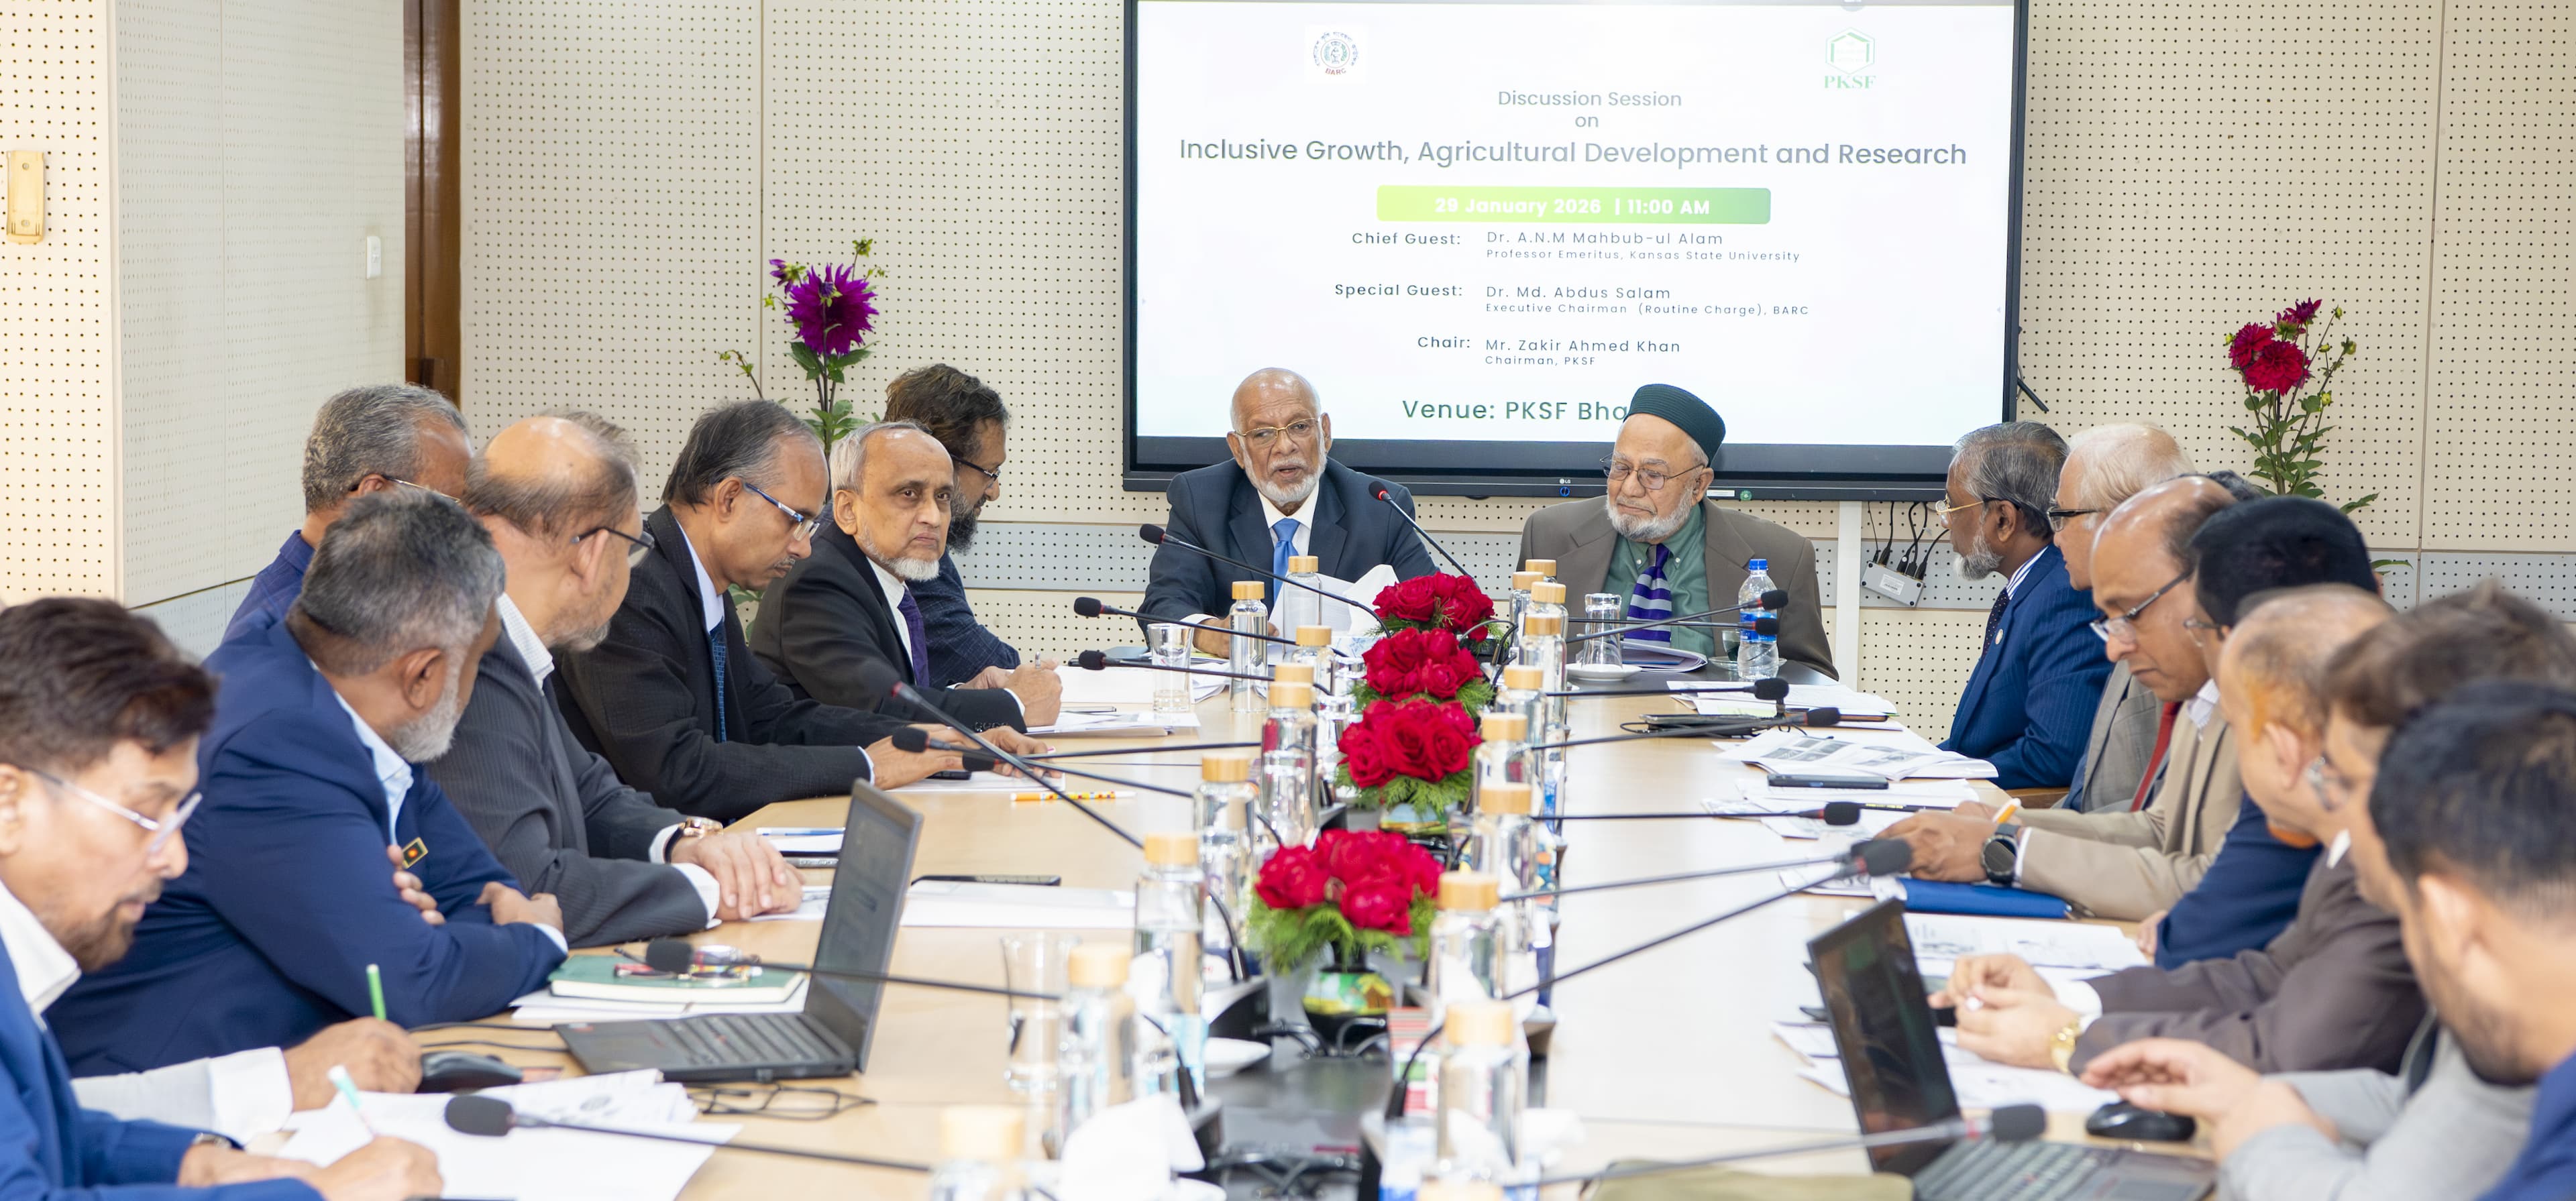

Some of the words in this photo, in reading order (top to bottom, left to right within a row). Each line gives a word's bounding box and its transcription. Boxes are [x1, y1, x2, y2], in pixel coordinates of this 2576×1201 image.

[1325, 68, 1347, 76] BARC
[1824, 75, 1877, 89] PKSF
[1498, 89, 1602, 106] Discussion
[1608, 91, 1682, 107] Session
[1574, 116, 1599, 128] on
[1181, 138, 1298, 160] Inclusive
[1305, 140, 1409, 164] Growth,
[1417, 139, 1576, 168] Agricultural
[1585, 141, 1768, 170] Development
[1776, 143, 1829, 164] and
[1839, 144, 1966, 164] Research
[1435, 198, 1459, 213] 29
[1465, 198, 1547, 217] January
[1554, 198, 1601, 214] 2026
[1627, 199, 1673, 214] 11:00
[1679, 200, 1710, 215] AM
[1352, 232, 1398, 244] Chief
[1405, 233, 1460, 245] Guest:
[1487, 231, 1509, 243] Dr.
[1517, 231, 1564, 243] A.N.M
[1572, 231, 1670, 244] Mahbub-ul
[1678, 233, 1723, 245] Alam
[1487, 249, 1552, 258] Professor
[1558, 249, 1623, 260] Emeritus,
[1629, 250, 1680, 260] Kansas
[1686, 251, 1723, 260] State
[1729, 251, 1800, 264] University
[1335, 284, 1400, 299] Special
[1407, 284, 1462, 296] Guest:
[1487, 286, 1509, 298] Dr.
[1517, 286, 1546, 298] Md.
[1554, 286, 1608, 298] Abdus
[1616, 287, 1670, 299] Salam
[1486, 303, 1552, 312] Executive
[1558, 303, 1627, 313] Chairman
[1638, 302, 1698, 316] (Routine
[1704, 303, 1766, 317] Charge),
[1773, 306, 1809, 315] BARC
[1417, 336, 1470, 349] Chair:
[1486, 339, 1511, 351] Mr.
[1518, 339, 1561, 351] Zakir
[1568, 339, 1629, 352] Ahmed
[1637, 340, 1680, 353] Khan
[1485, 355, 1558, 367] Chairman,
[1564, 356, 1595, 365] PKSF
[1402, 400, 1495, 419] Venue:
[1506, 401, 1568, 420] PKSF
